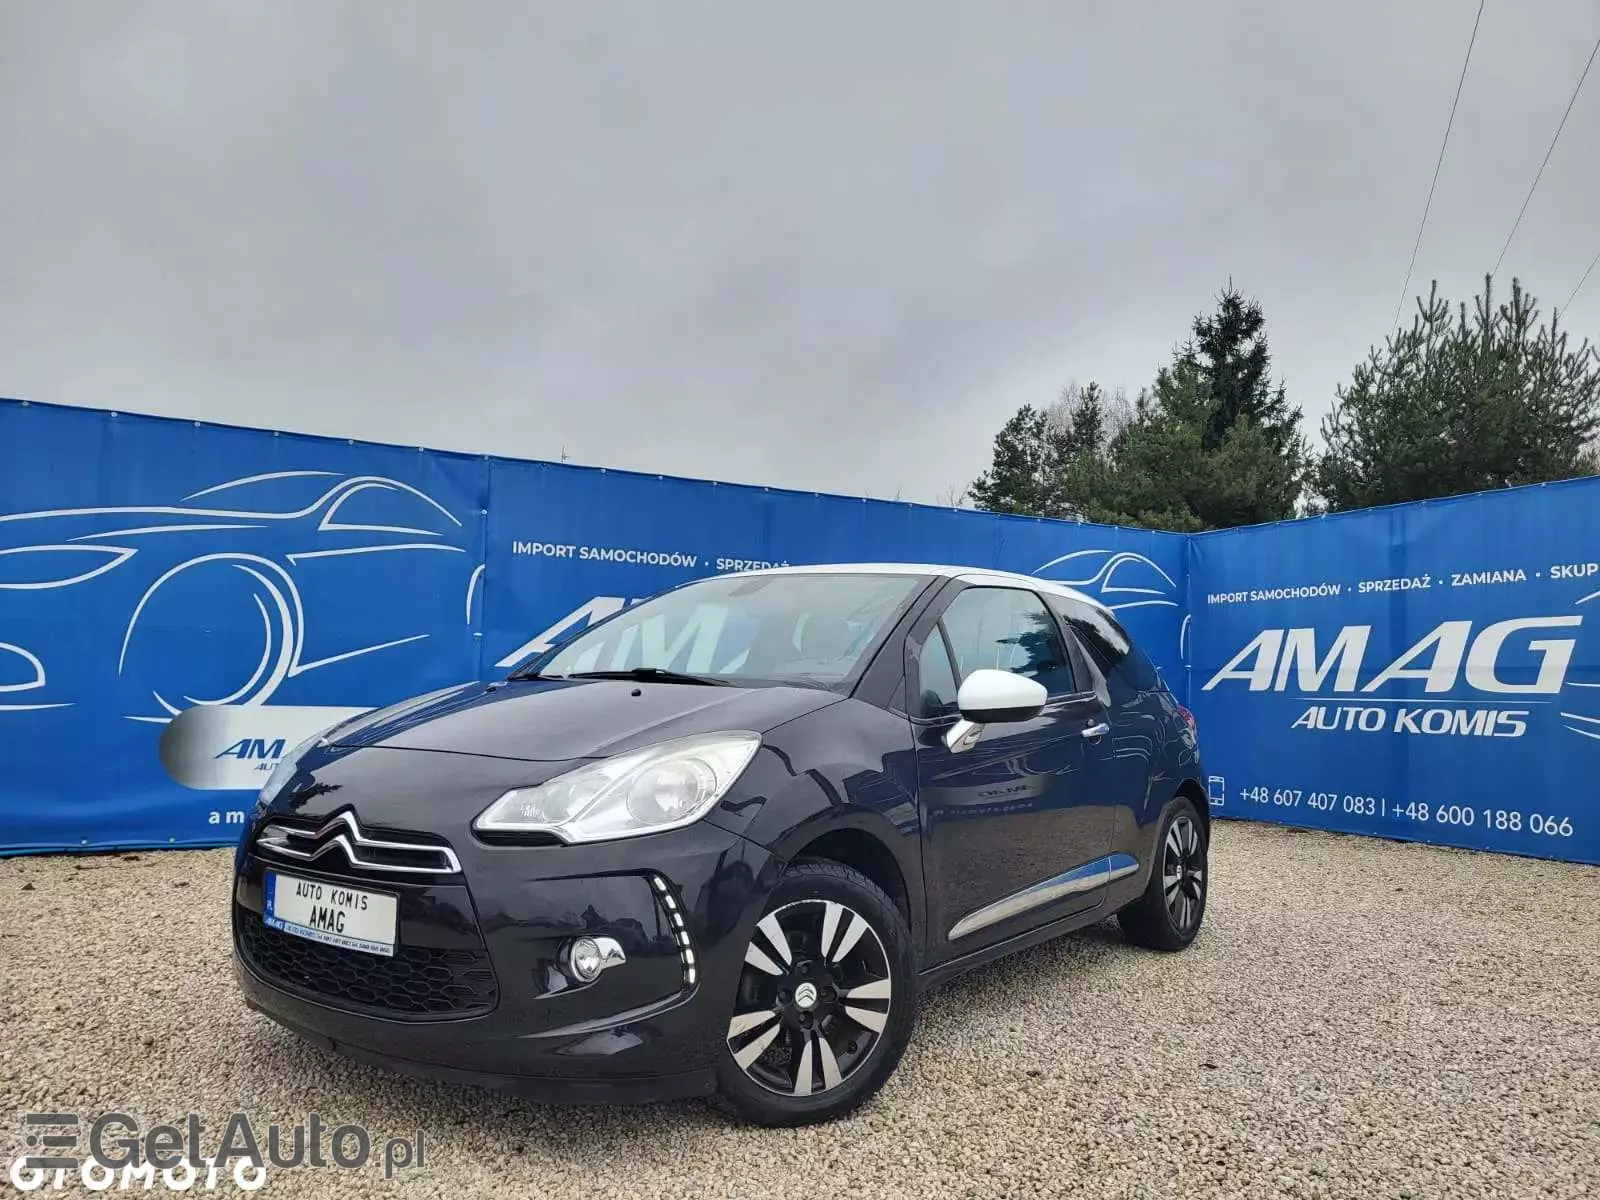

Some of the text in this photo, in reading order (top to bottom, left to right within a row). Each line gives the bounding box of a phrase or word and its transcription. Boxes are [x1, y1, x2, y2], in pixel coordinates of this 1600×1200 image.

[512, 541, 576, 559] IMPORT
[579, 546, 697, 568] SAMOCHODÓW
[1207, 562, 1599, 604] IMPORT SAMOCHODÓW SPRZEDAŻ ZAMIANA SKUP
[1291, 706, 1529, 738] AUTO KOMIS
[1239, 787, 1574, 837] +48 607 407 083 +48 600 188 066
[296, 882, 369, 911] AUTO KOMIS
[309, 905, 346, 933] AMAG
